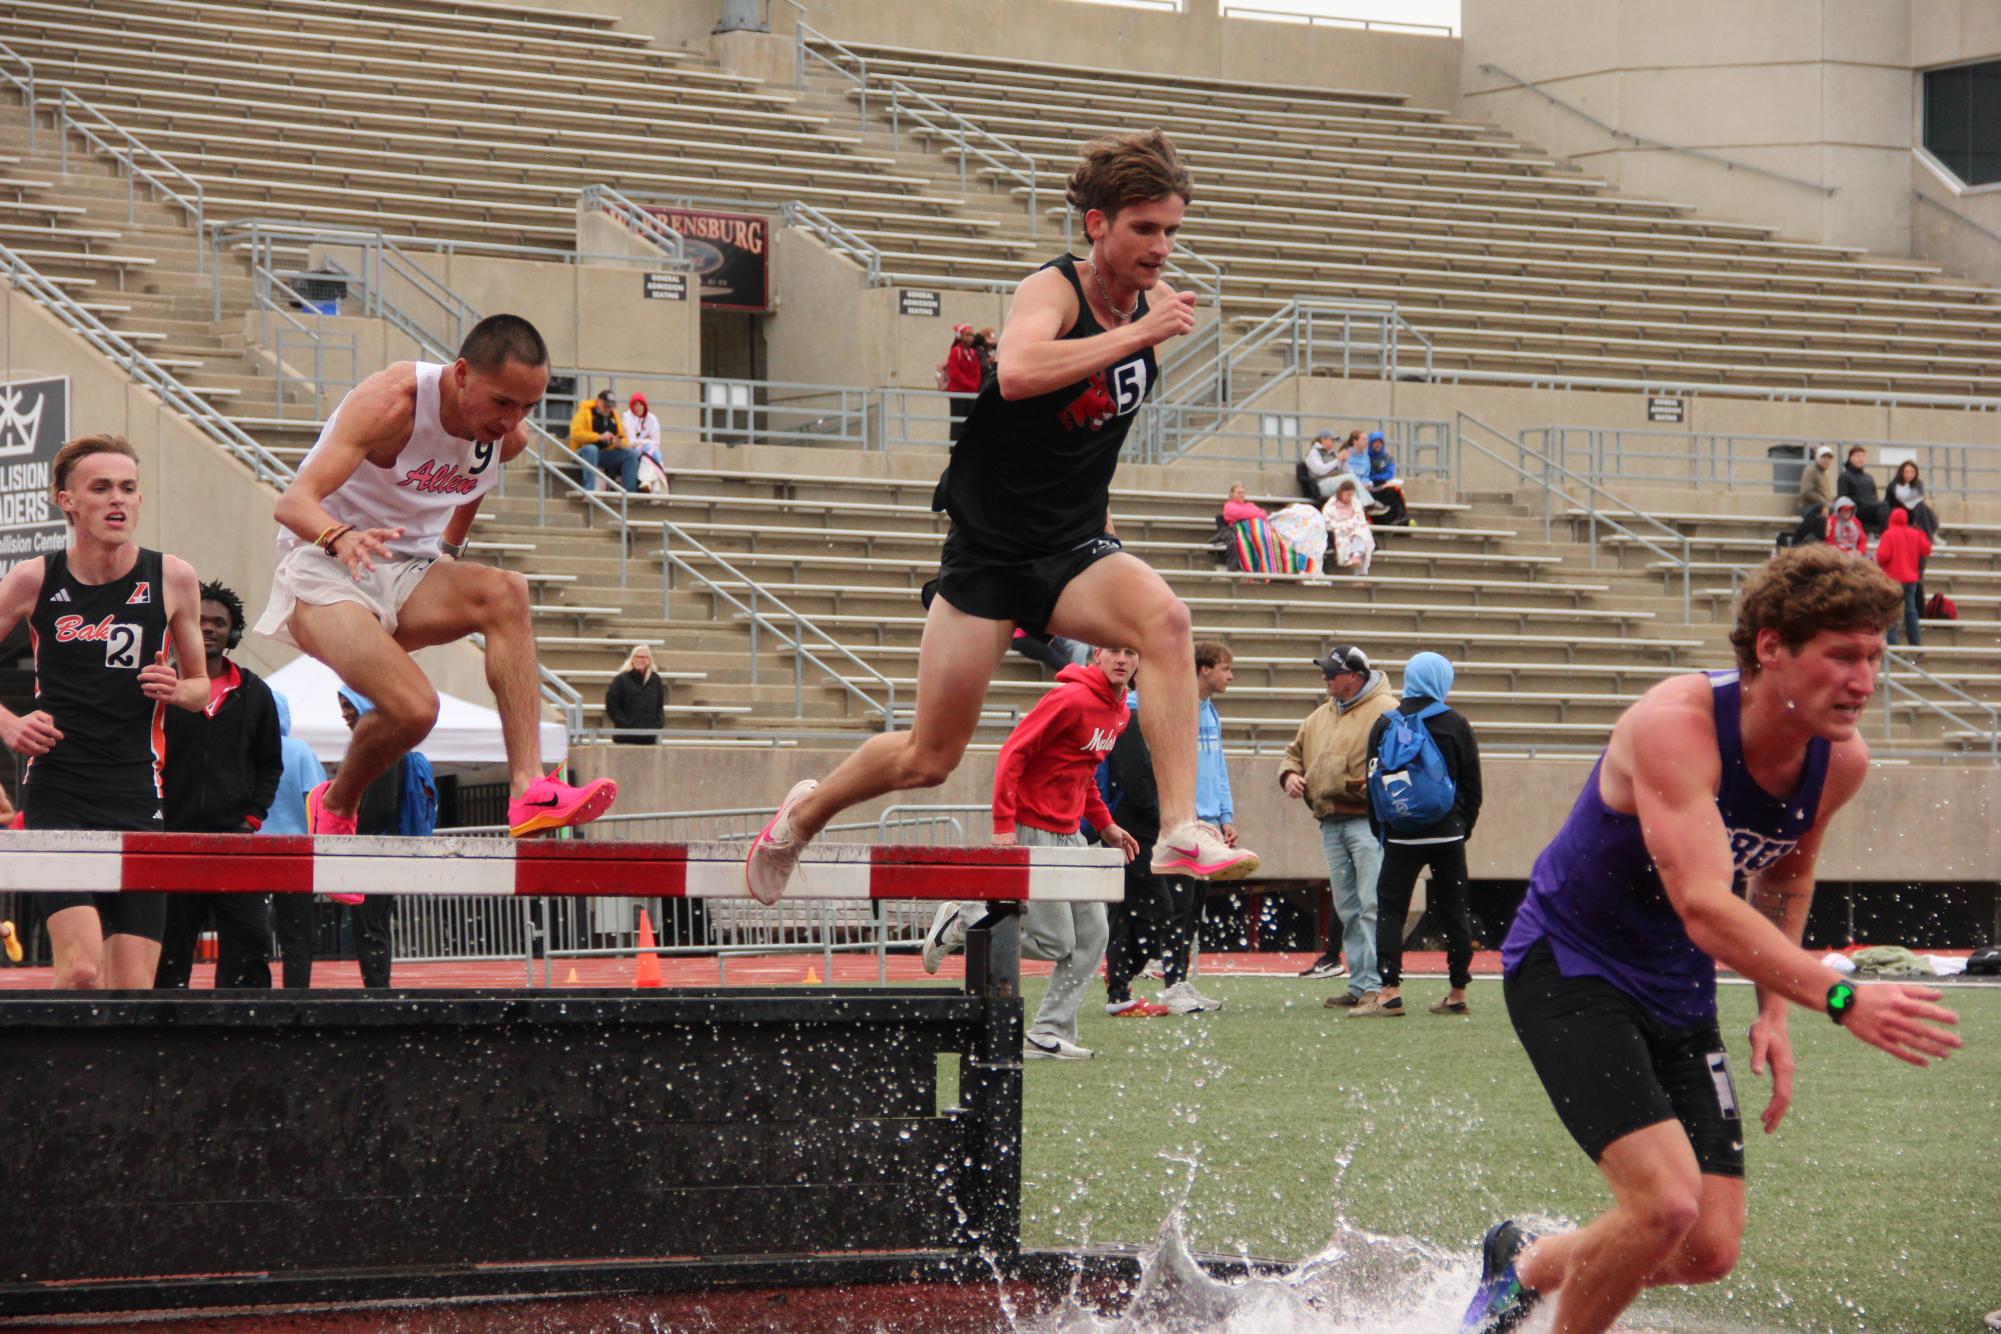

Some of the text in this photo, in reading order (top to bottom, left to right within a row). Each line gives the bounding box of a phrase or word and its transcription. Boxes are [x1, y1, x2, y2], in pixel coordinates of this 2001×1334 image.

[608, 210, 763, 255] WRRENSBURG
[647, 282, 684, 292] ADMISSION
[651, 274, 680, 283] GENERAL
[652, 291, 680, 299] SEATING
[903, 299, 938, 308] ADMISSION
[1118, 365, 1140, 413] 5
[469, 440, 494, 475] 9
[397, 459, 478, 495] Allen
[34, 531, 67, 551] Center
[107, 626, 135, 667] 2
